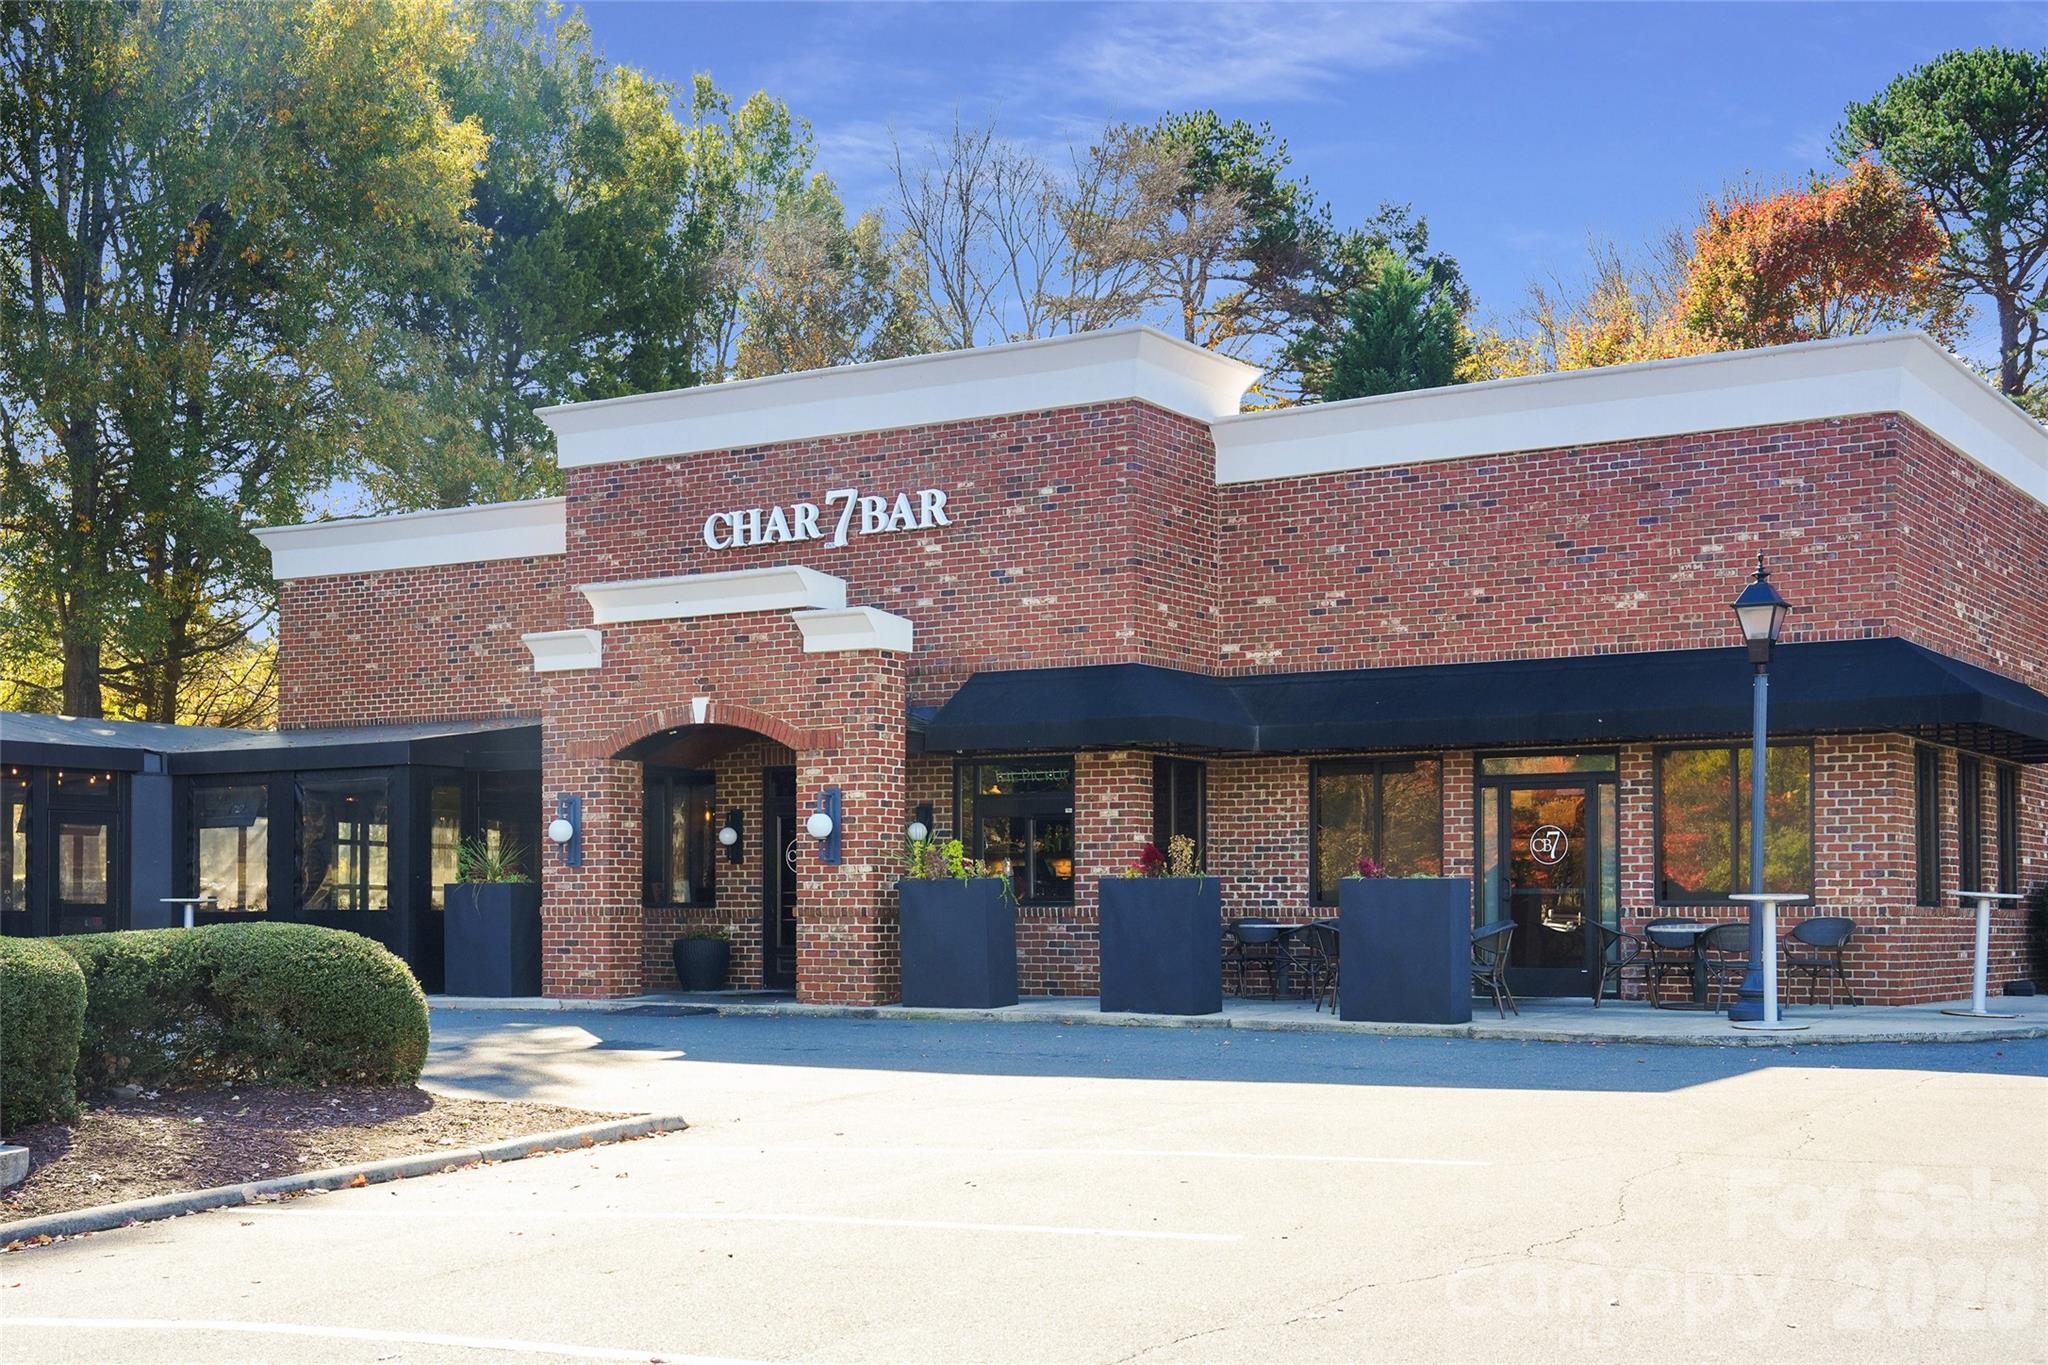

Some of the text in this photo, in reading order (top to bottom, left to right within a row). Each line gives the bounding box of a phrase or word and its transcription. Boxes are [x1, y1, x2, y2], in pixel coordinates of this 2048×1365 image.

[704, 488, 952, 550] CHAR 7 BAR
